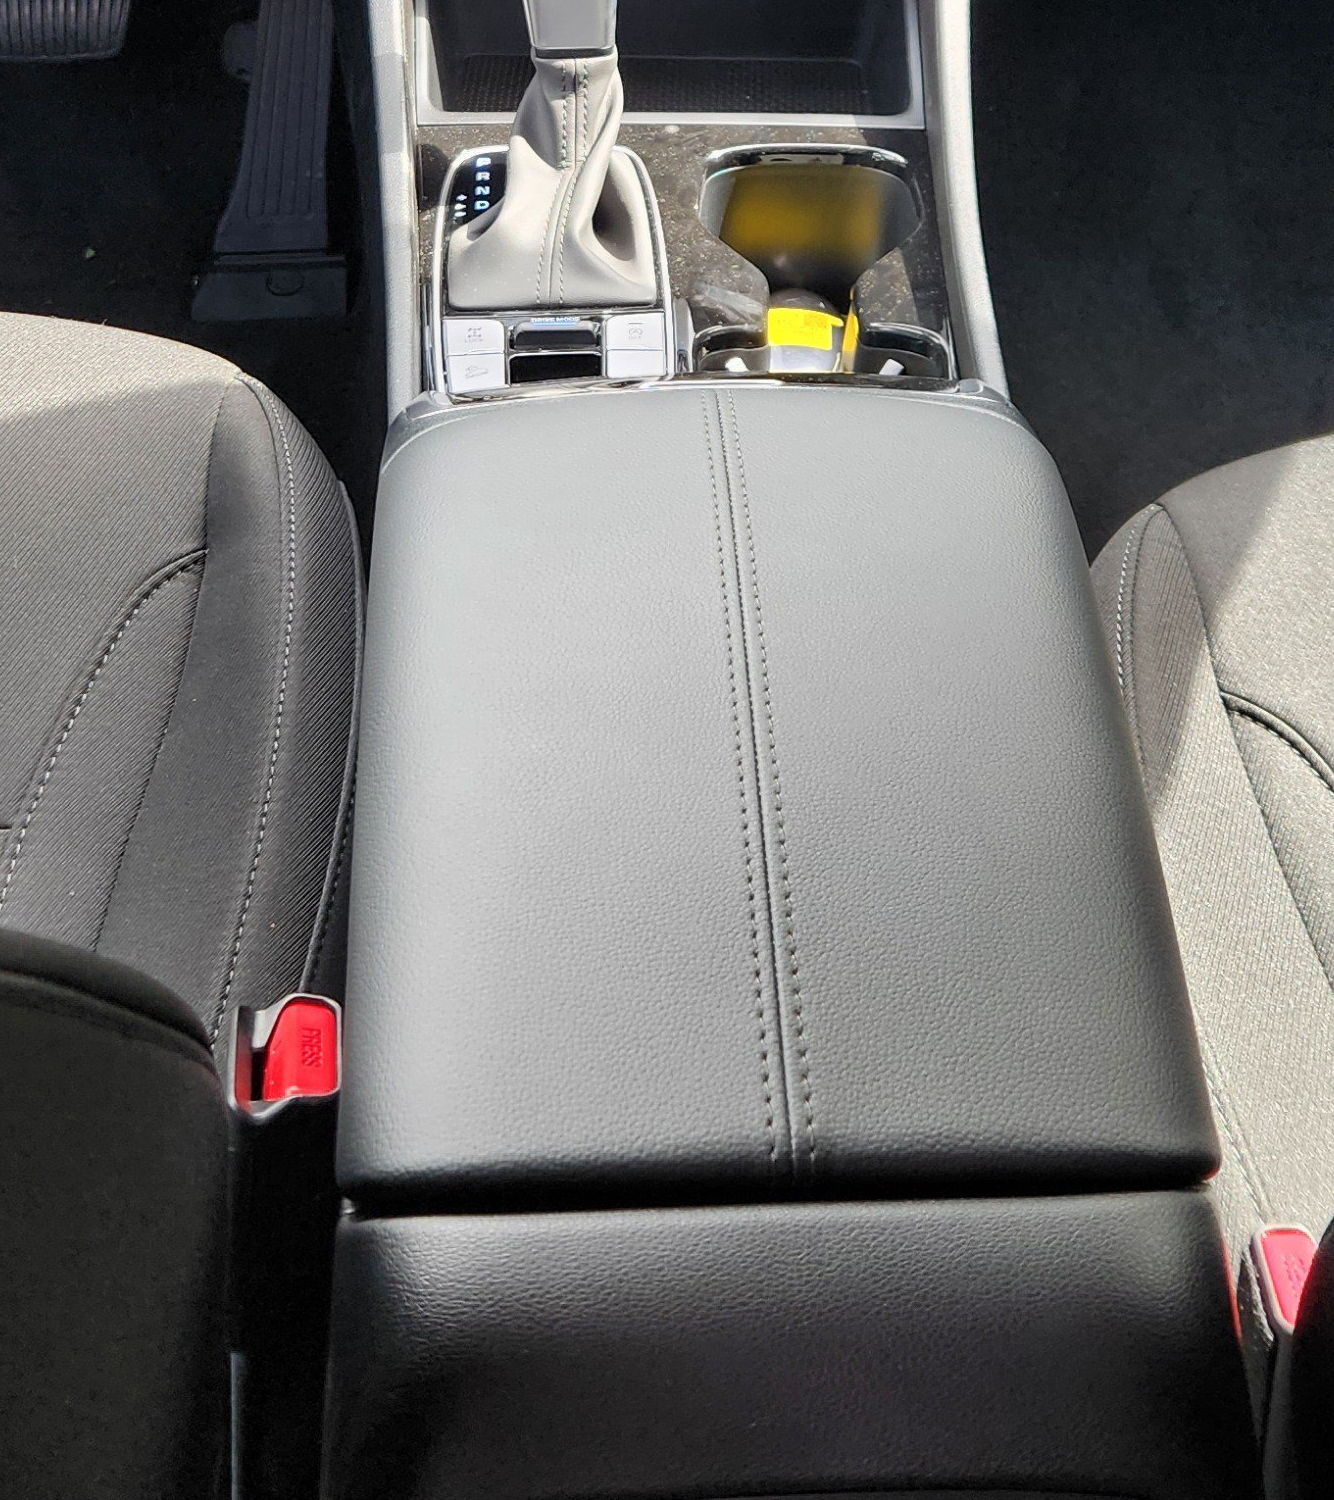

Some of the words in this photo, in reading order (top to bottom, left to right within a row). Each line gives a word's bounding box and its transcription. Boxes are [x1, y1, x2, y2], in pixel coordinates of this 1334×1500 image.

[474, 185, 490, 196] N
[473, 200, 490, 210] D
[300, 1027, 324, 1068] PRESS
